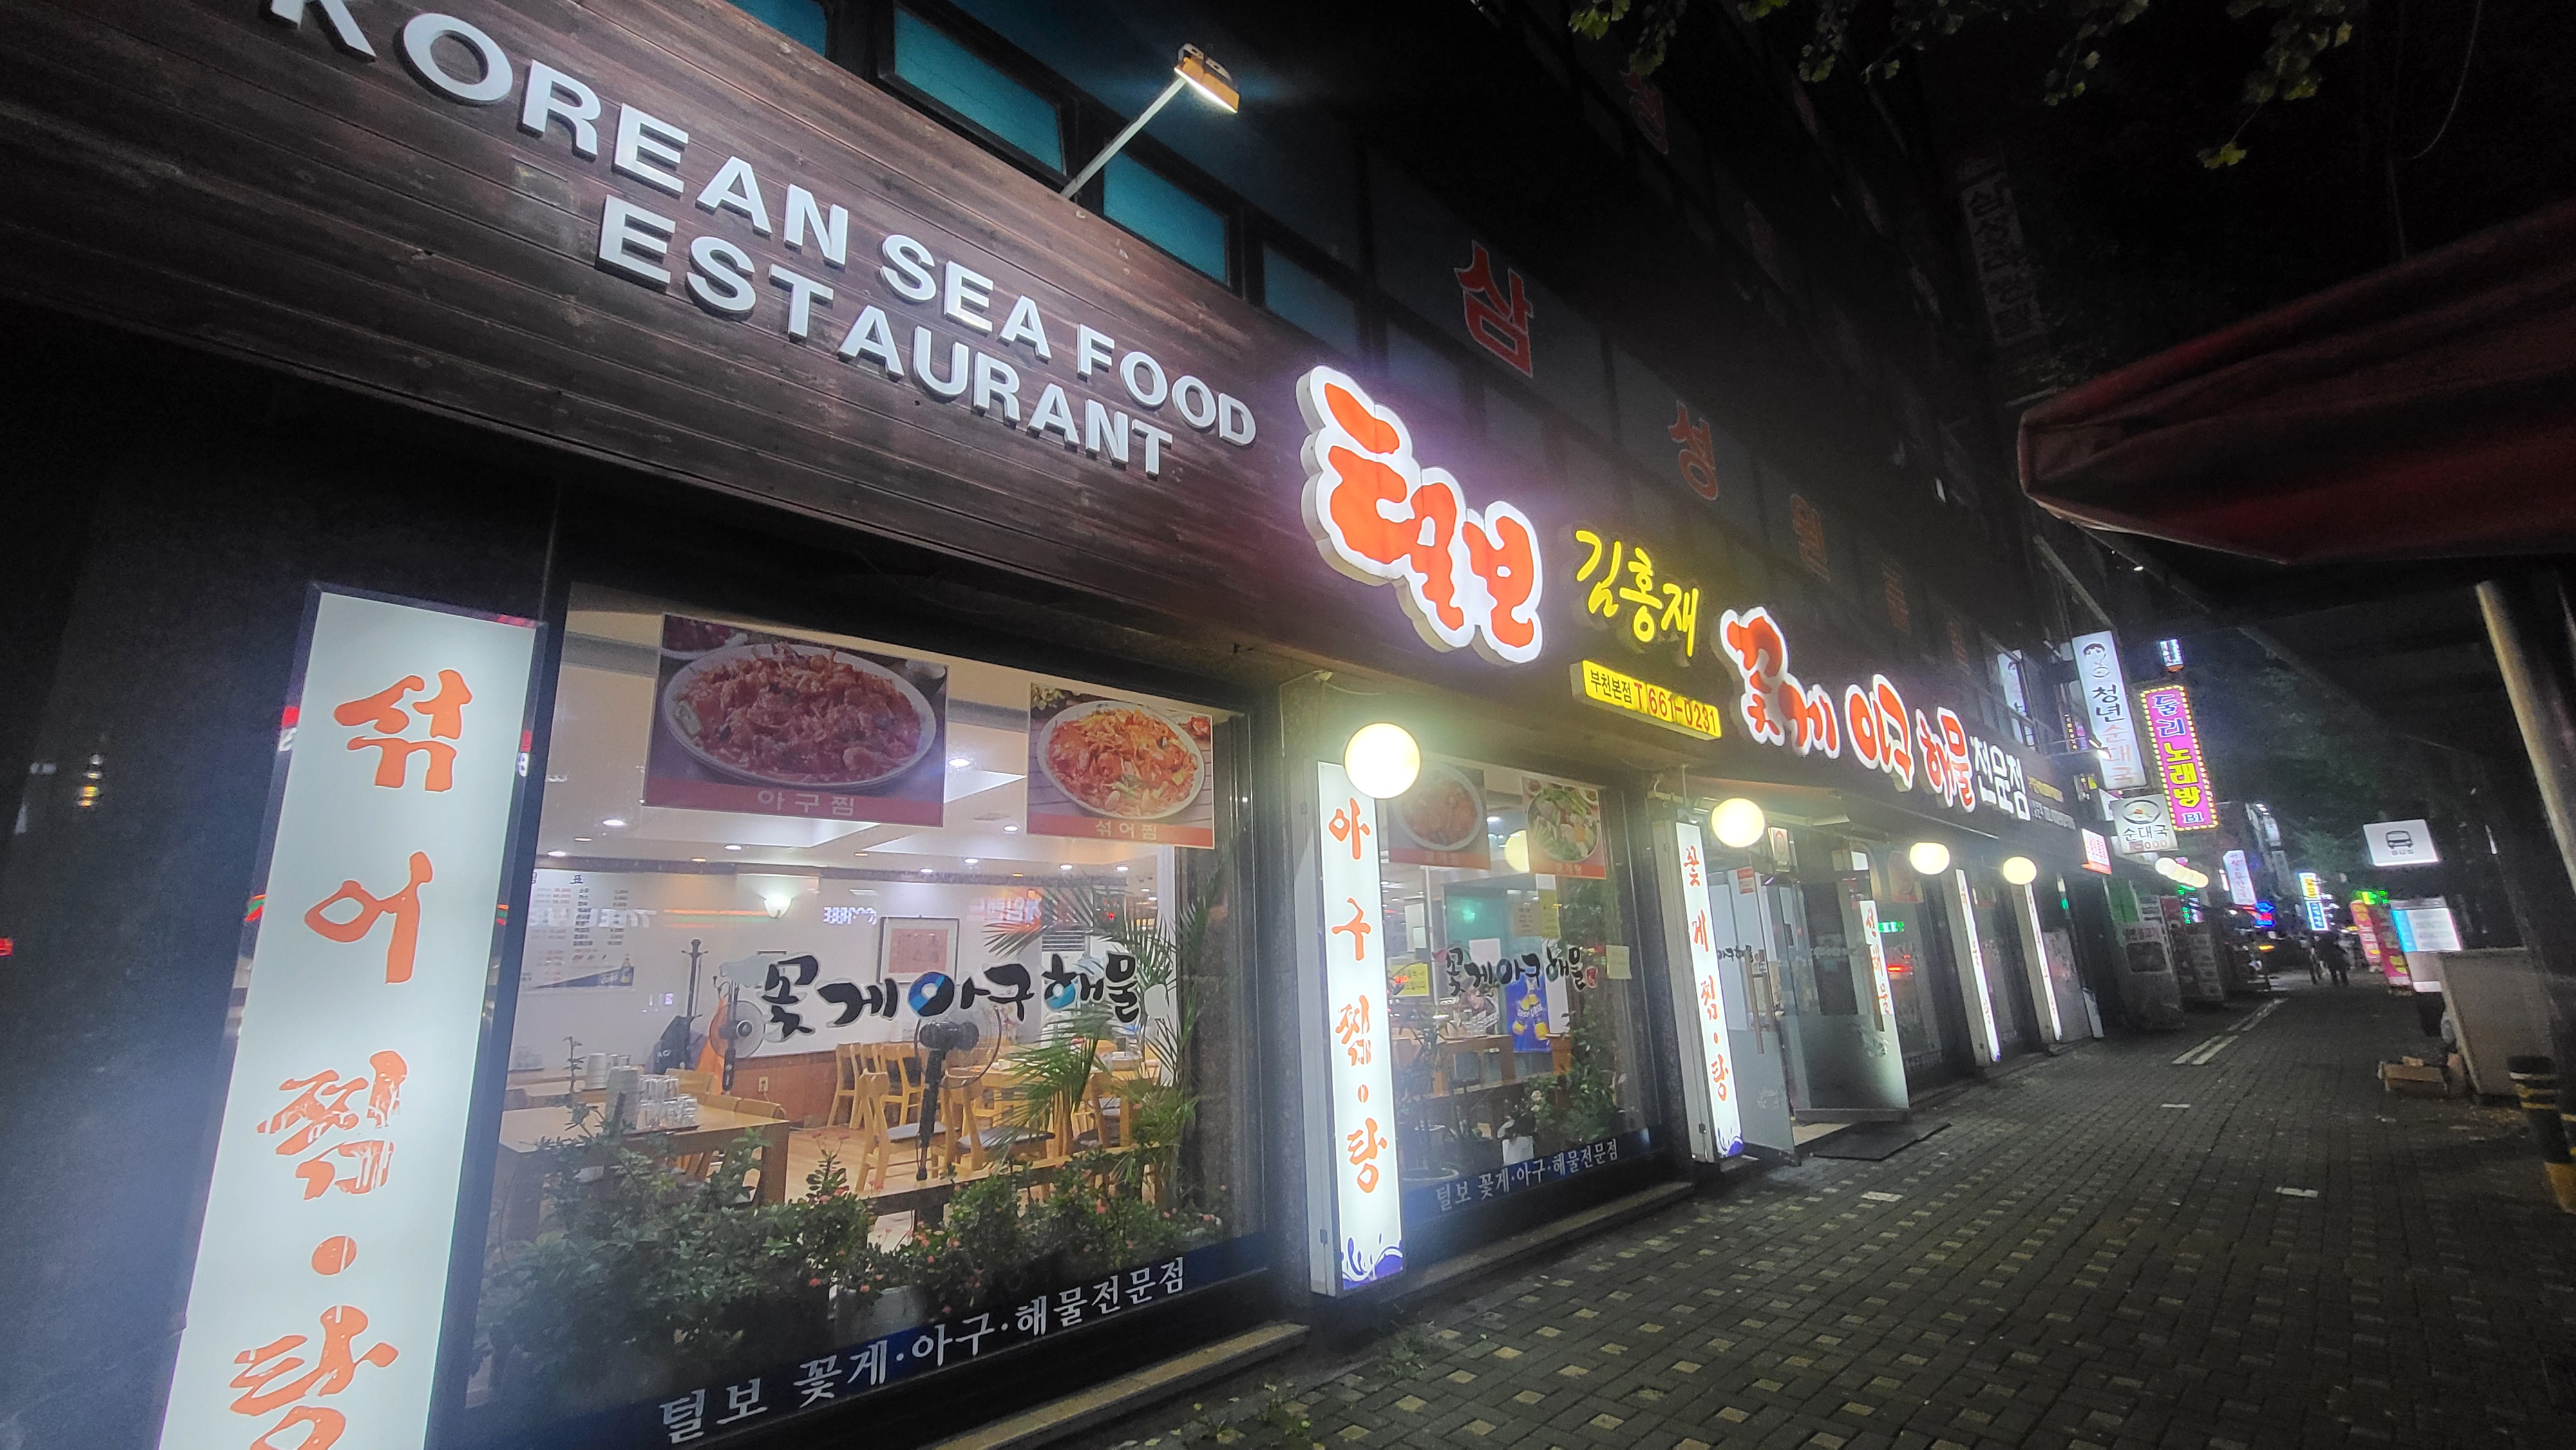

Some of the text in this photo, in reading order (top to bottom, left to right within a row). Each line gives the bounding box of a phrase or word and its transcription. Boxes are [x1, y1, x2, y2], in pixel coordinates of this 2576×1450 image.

[596, 194, 1173, 478] ESTAURANT
[880, 234, 1052, 362] SEA
[1077, 323, 1256, 447] FOOD
[1323, 381, 1535, 649] 털보
[1575, 529, 1700, 657] 김홍재
[1589, 668, 1633, 705] 부천본점
[1647, 687, 1717, 733] 661-0231
[755, 789, 855, 817] 아구찜
[2164, 742, 2202, 808] 노래방
[2123, 825, 2169, 842] 순대국
[1437, 1180, 1472, 1212] 털보
[659, 1377, 768, 1445] 털보
